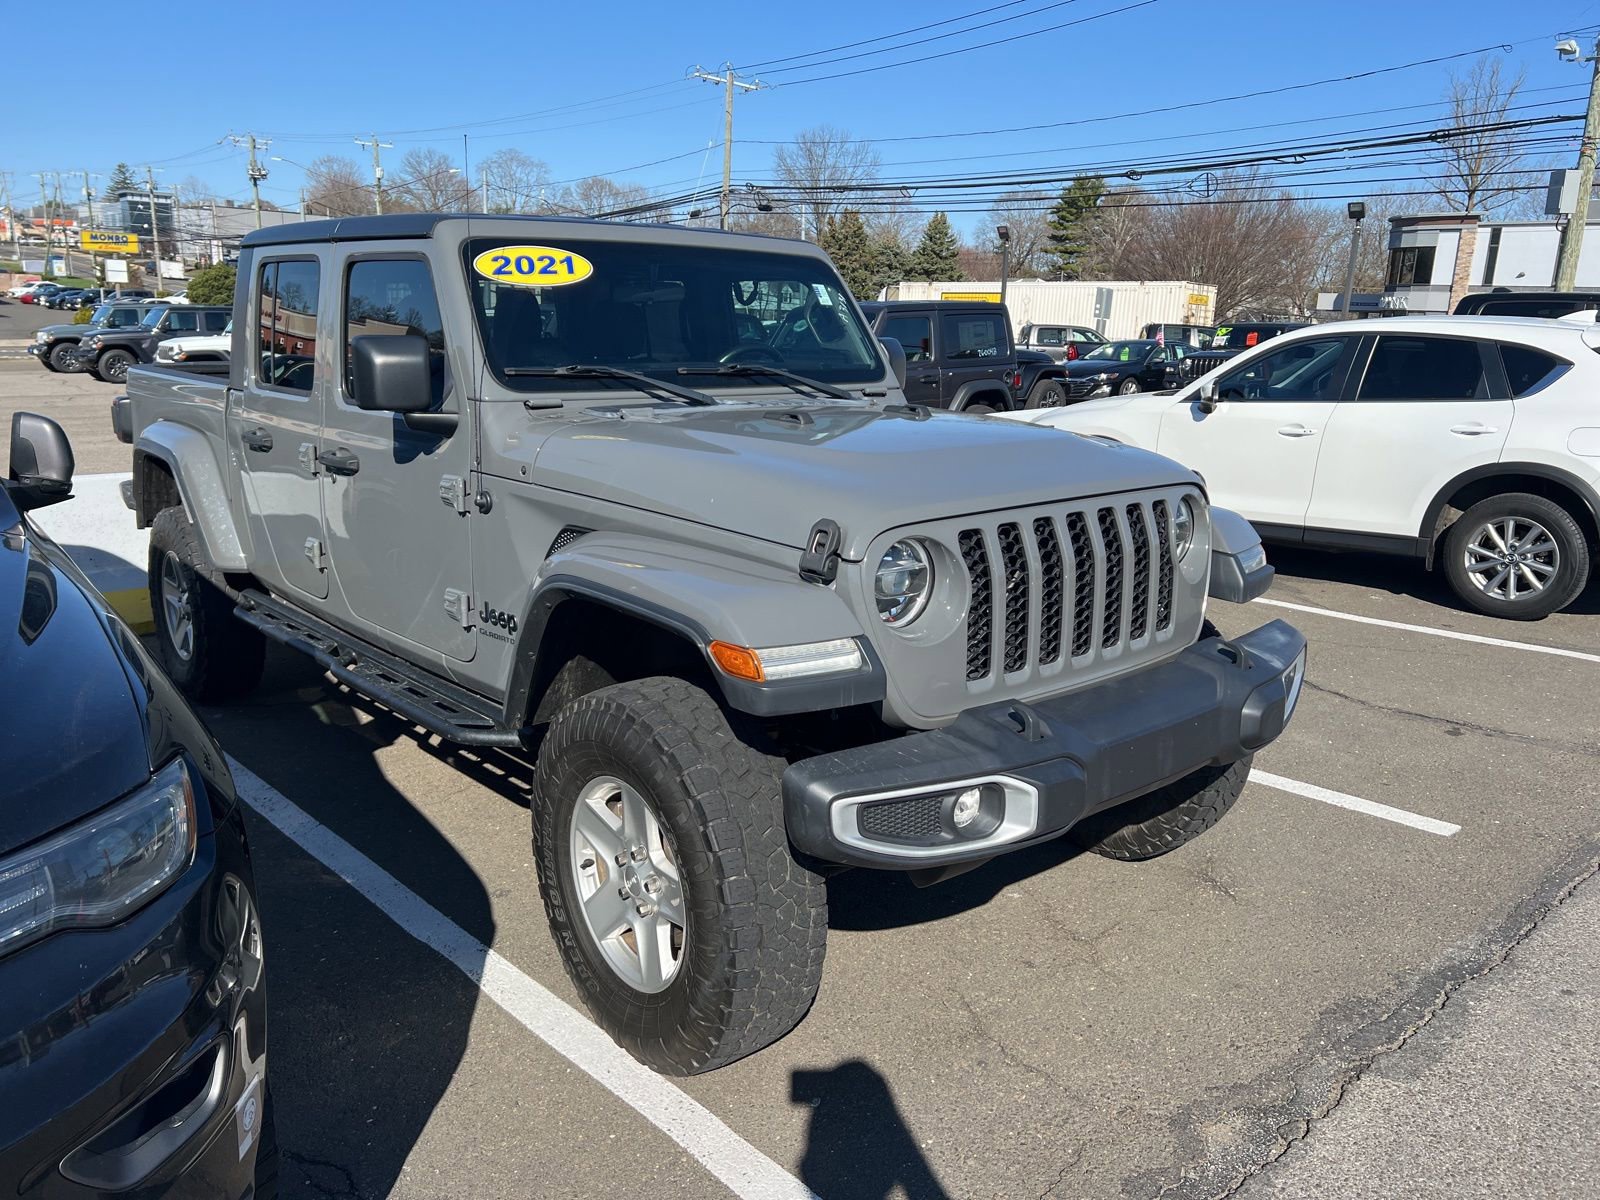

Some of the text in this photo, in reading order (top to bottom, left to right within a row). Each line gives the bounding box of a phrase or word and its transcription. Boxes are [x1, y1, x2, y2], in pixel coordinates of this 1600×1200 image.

[90, 233, 129, 242] MONRO
[491, 255, 575, 275] 2021
[479, 600, 518, 636] Jeep
[561, 929, 600, 993] OPEN
